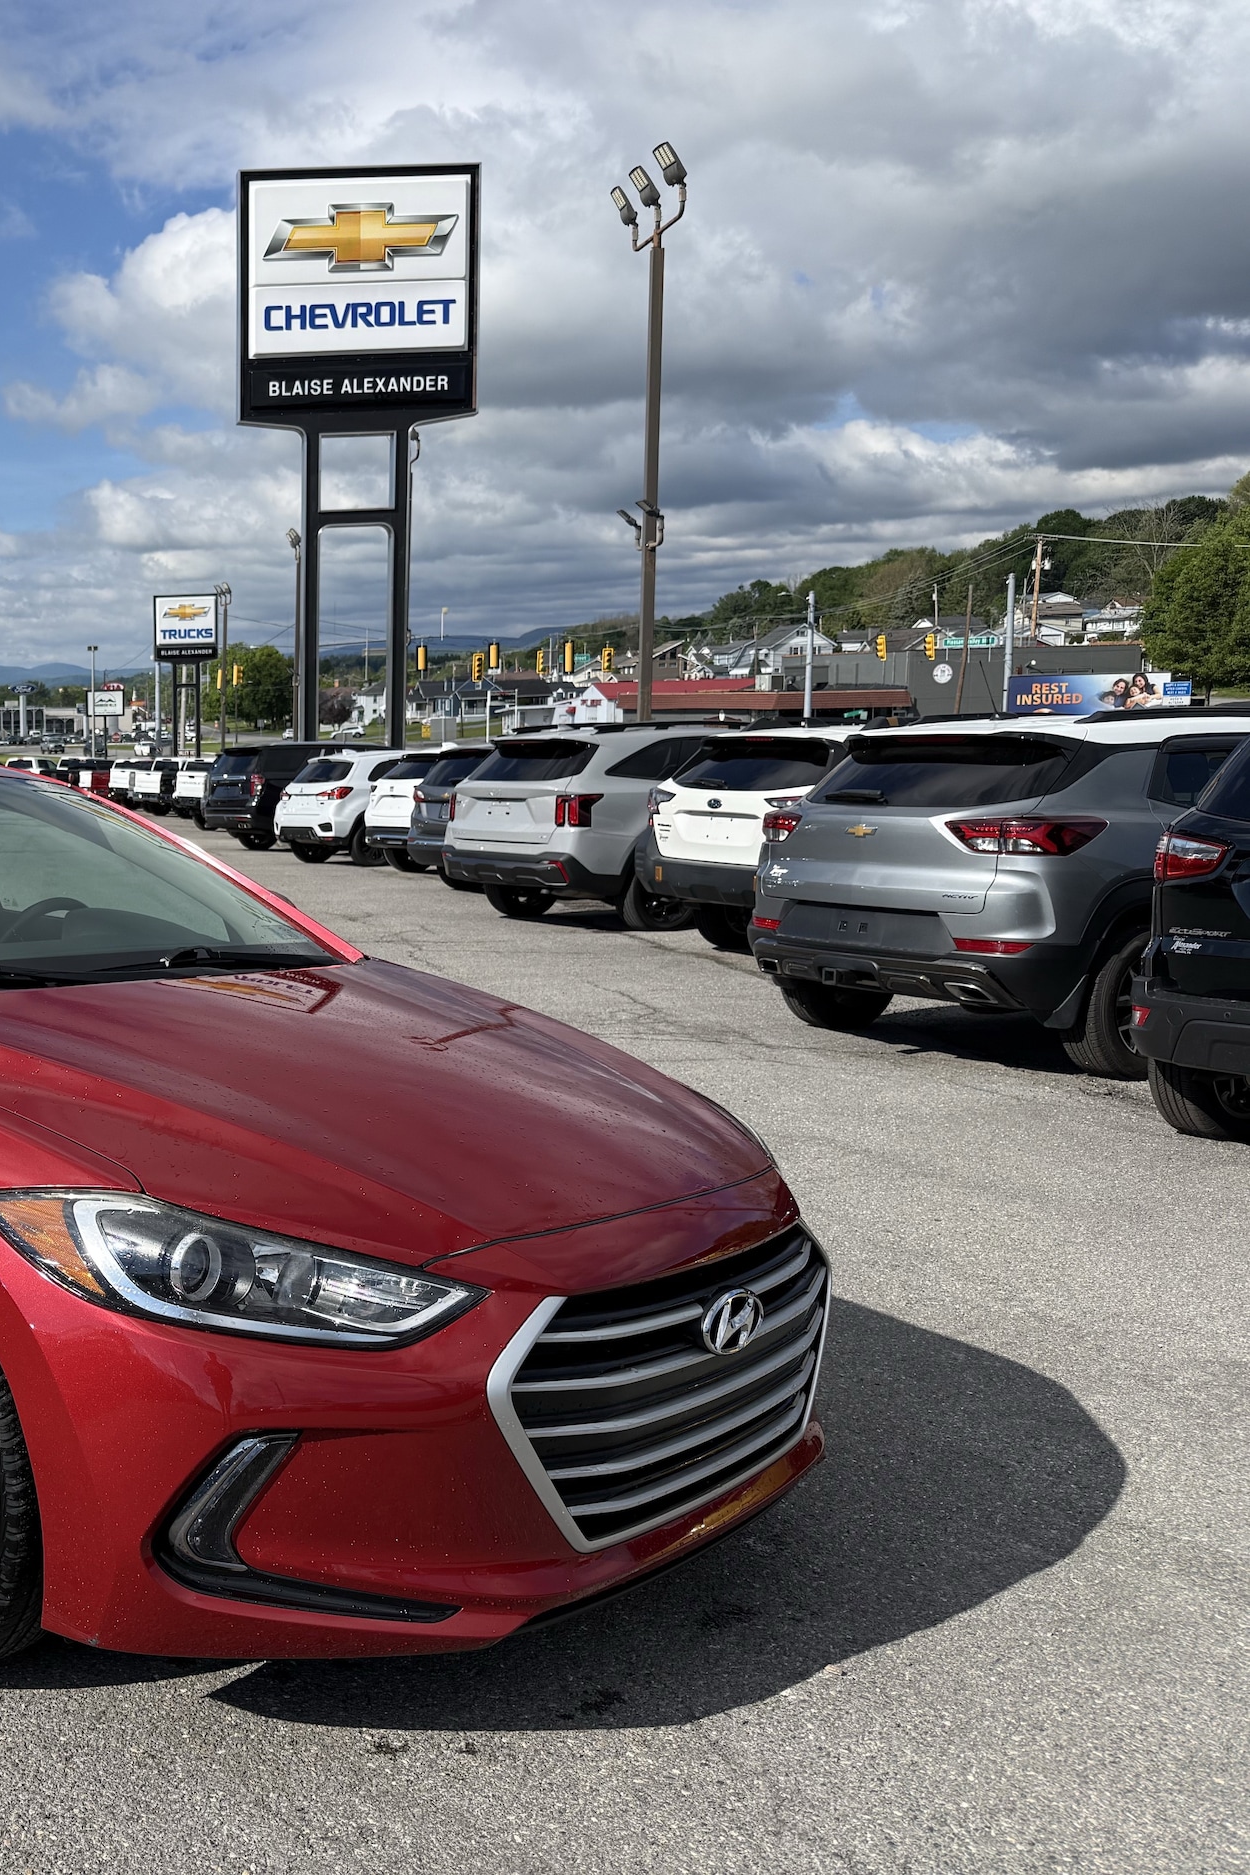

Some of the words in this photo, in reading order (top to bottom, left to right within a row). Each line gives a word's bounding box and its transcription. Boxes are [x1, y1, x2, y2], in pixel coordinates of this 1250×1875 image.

[263, 299, 456, 332] CHEVROLET
[268, 379, 334, 397] BLAISE
[340, 375, 449, 395] ALEXANDER
[160, 628, 213, 639] TRUCKS
[181, 648, 213, 656] ALEXANDER
[13, 685, 33, 694] Ford
[1031, 682, 1069, 694] REST
[1016, 692, 1083, 706] INSURED
